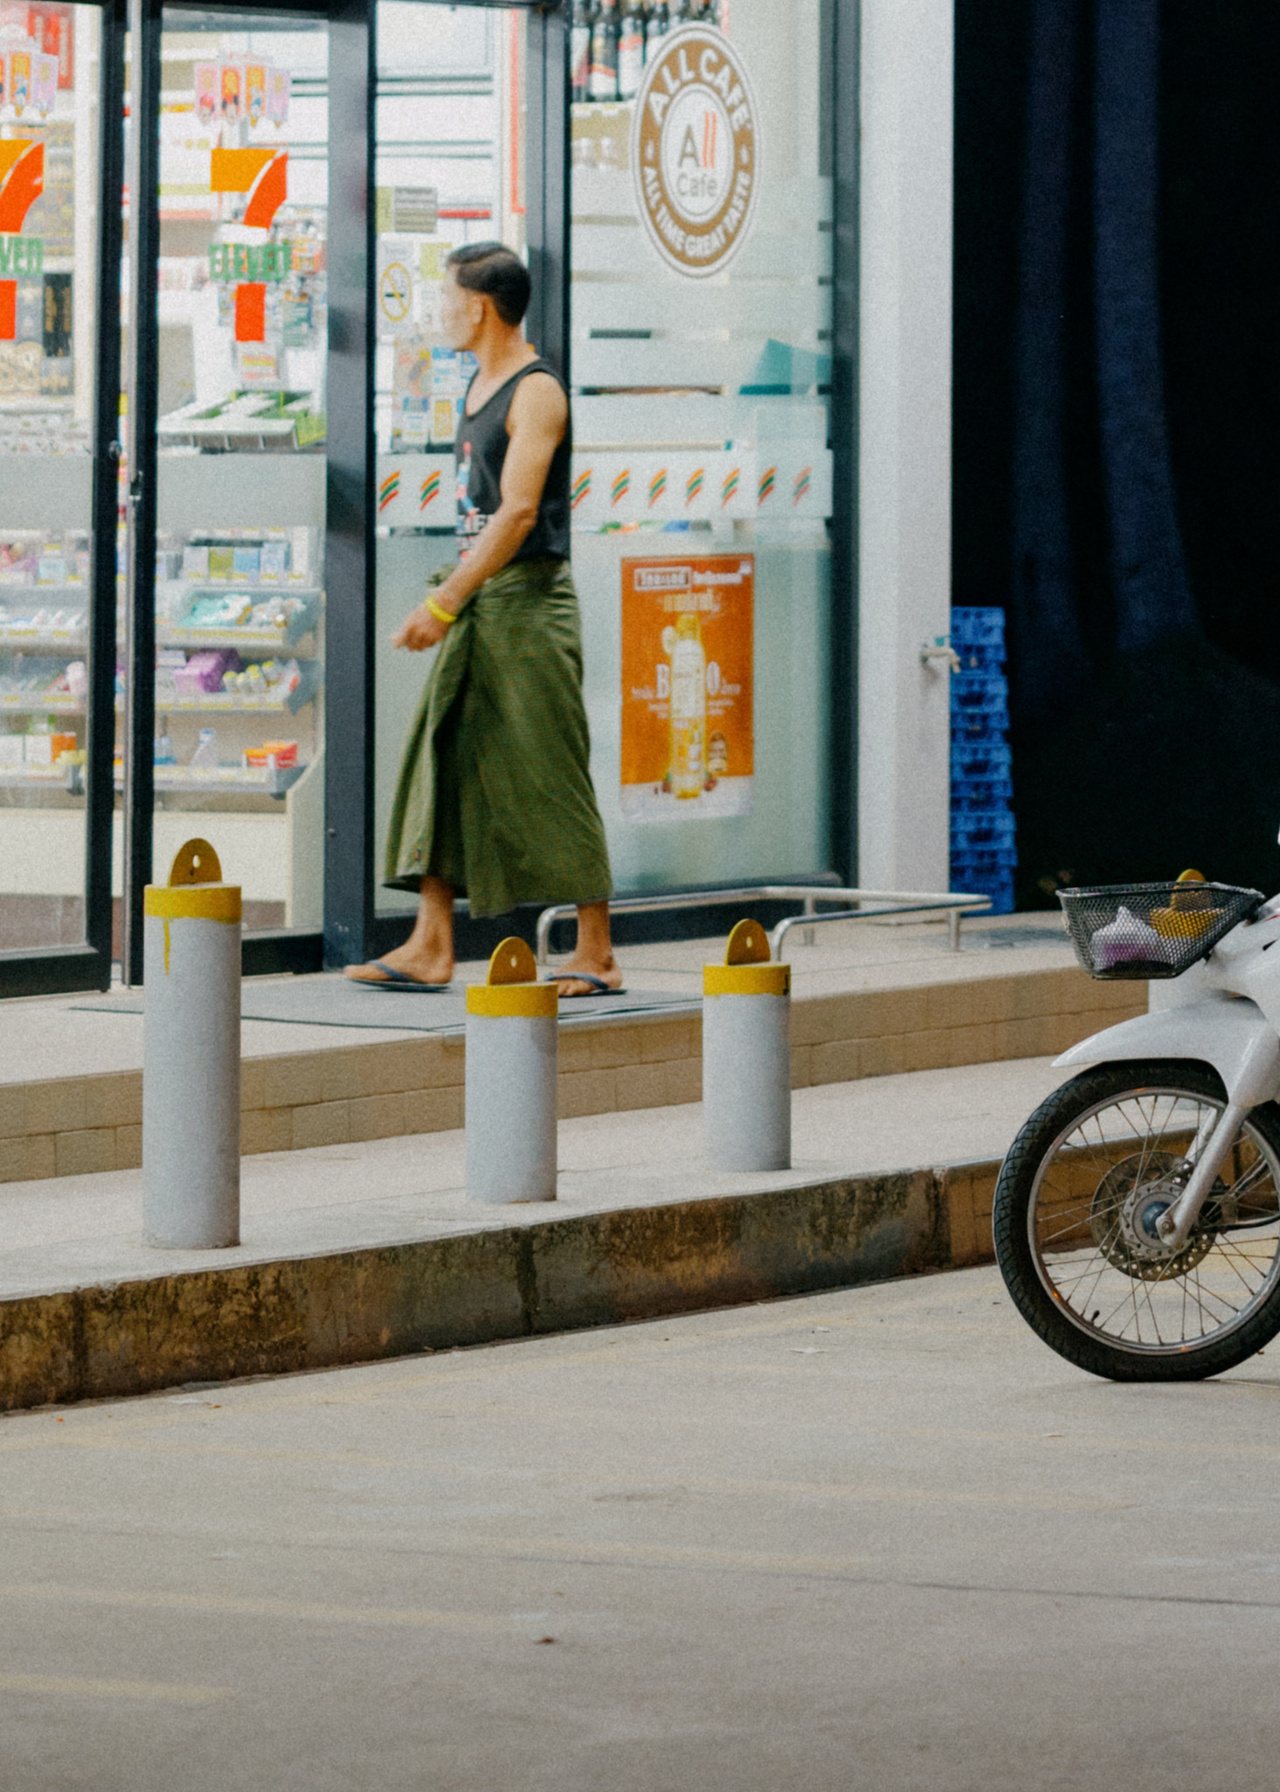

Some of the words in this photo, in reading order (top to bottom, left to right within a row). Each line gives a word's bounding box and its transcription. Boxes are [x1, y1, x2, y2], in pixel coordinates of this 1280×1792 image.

[649, 48, 695, 126] ALL
[699, 48, 751, 131] CAFE
[678, 111, 717, 168] All
[643, 165, 662, 209] ALL
[656, 203, 686, 251] TIME
[684, 224, 727, 258] GREAT
[722, 170, 751, 234] TASTE
[676, 172, 719, 199] Cafe
